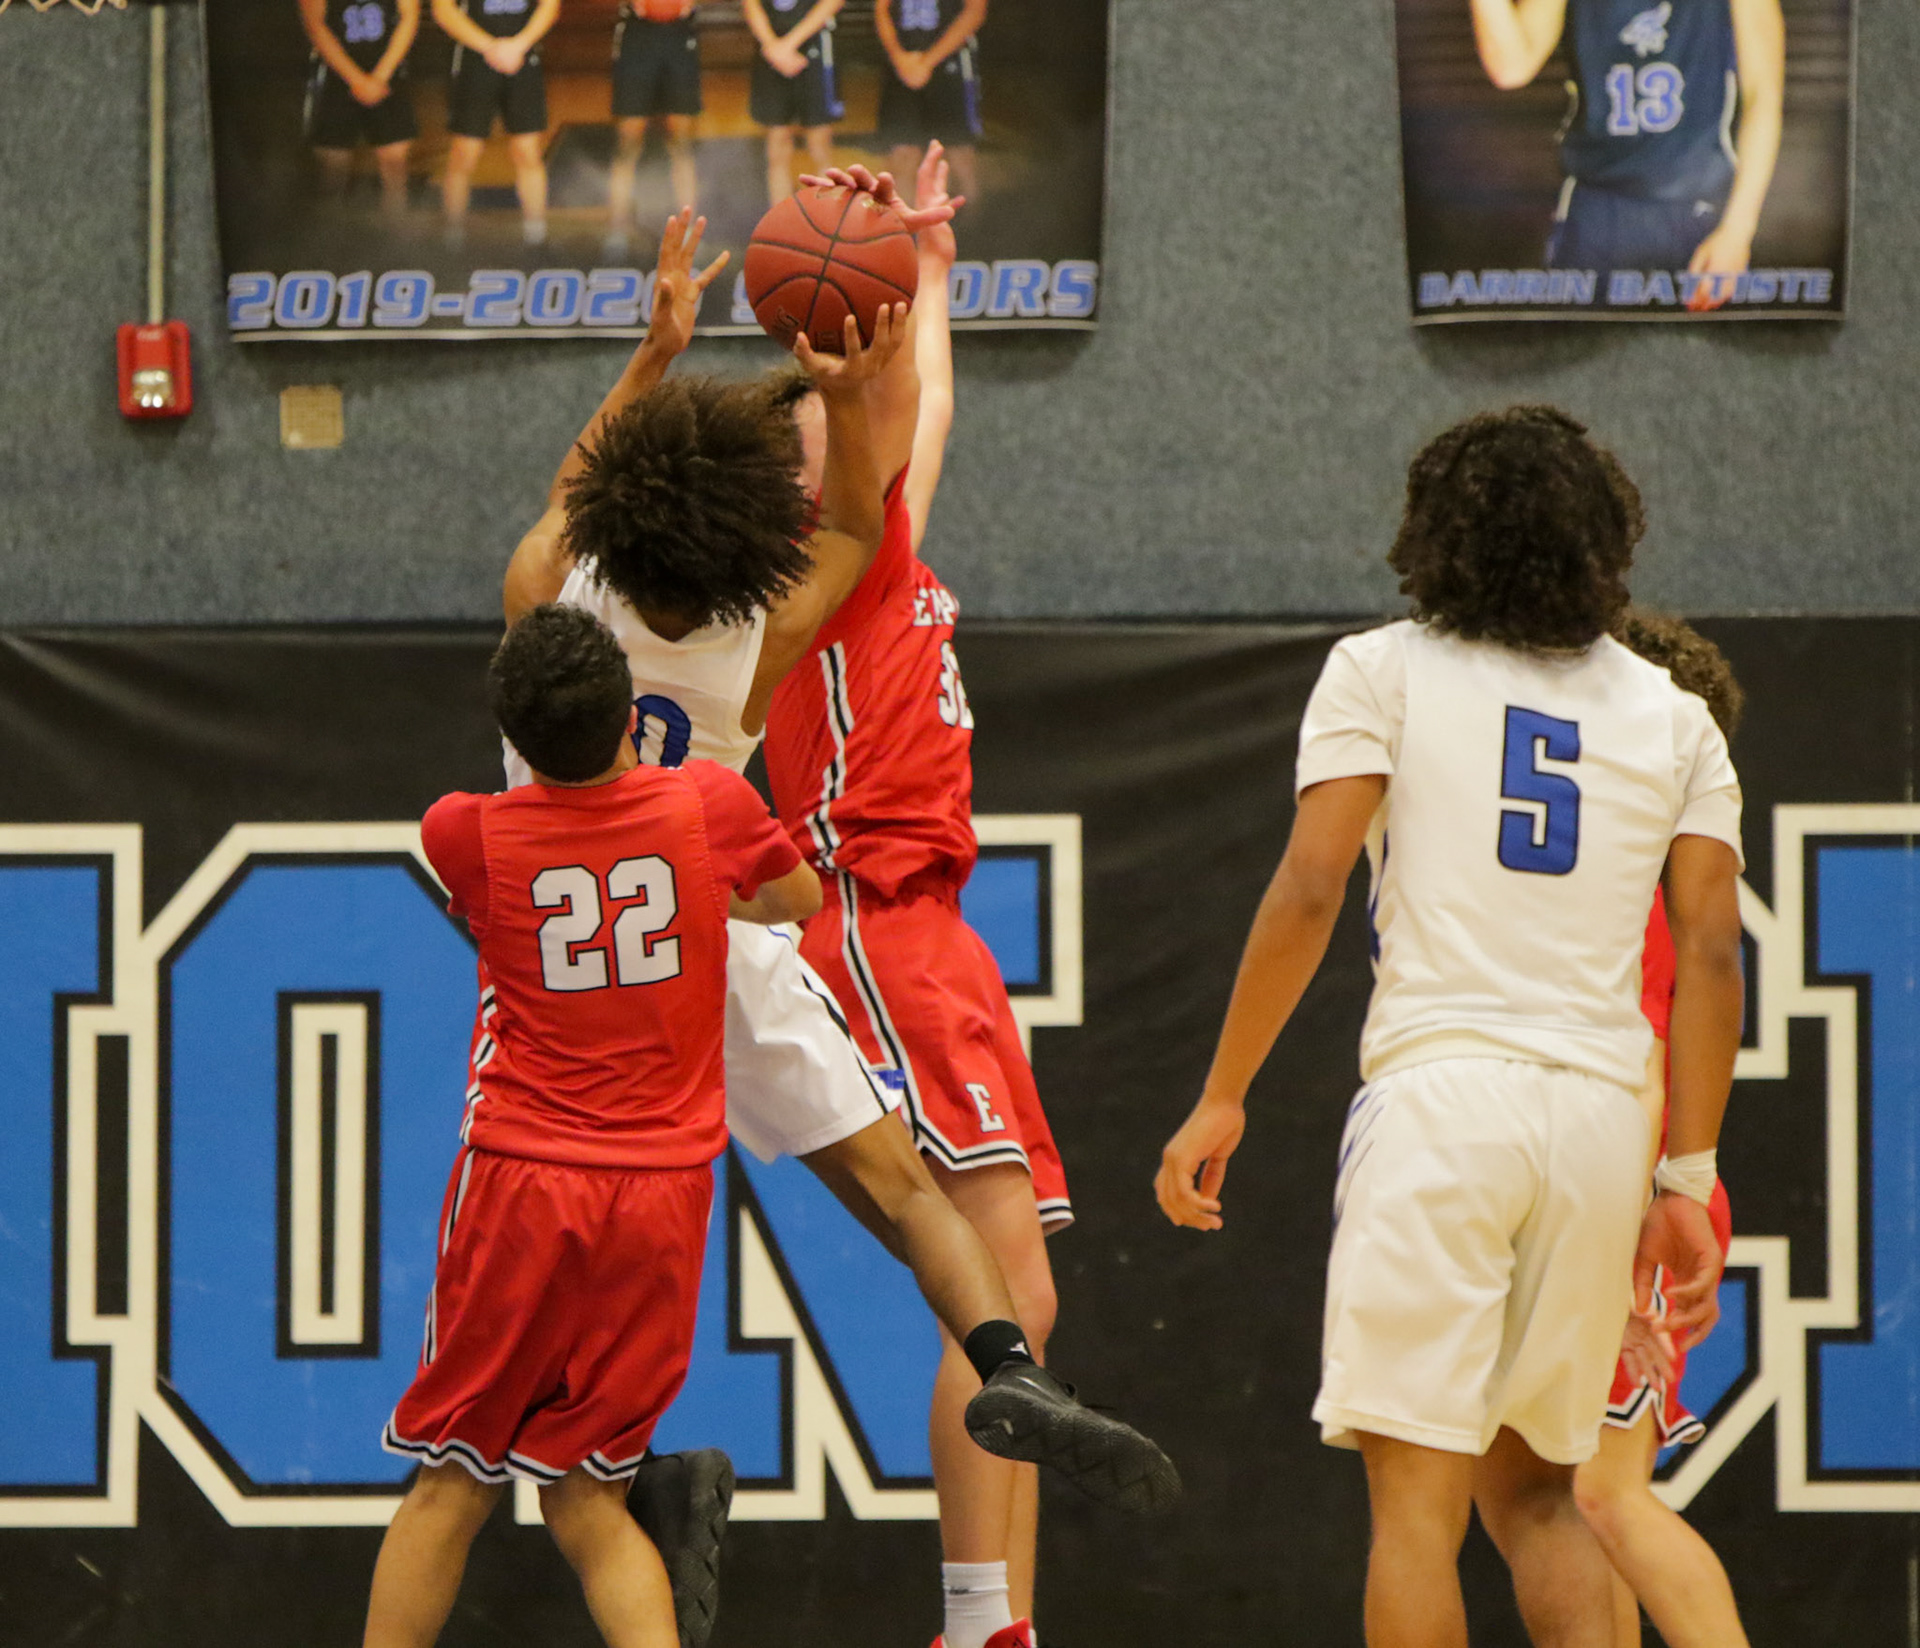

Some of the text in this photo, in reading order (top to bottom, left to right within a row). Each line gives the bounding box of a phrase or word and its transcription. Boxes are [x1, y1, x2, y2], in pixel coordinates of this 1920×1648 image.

[1606, 62, 1685, 136] 13
[1419, 268, 1833, 306] DARRIN BATTISTE
[1496, 704, 1581, 876] 5
[530, 853, 683, 993] 22
[964, 1082, 1007, 1133] E
